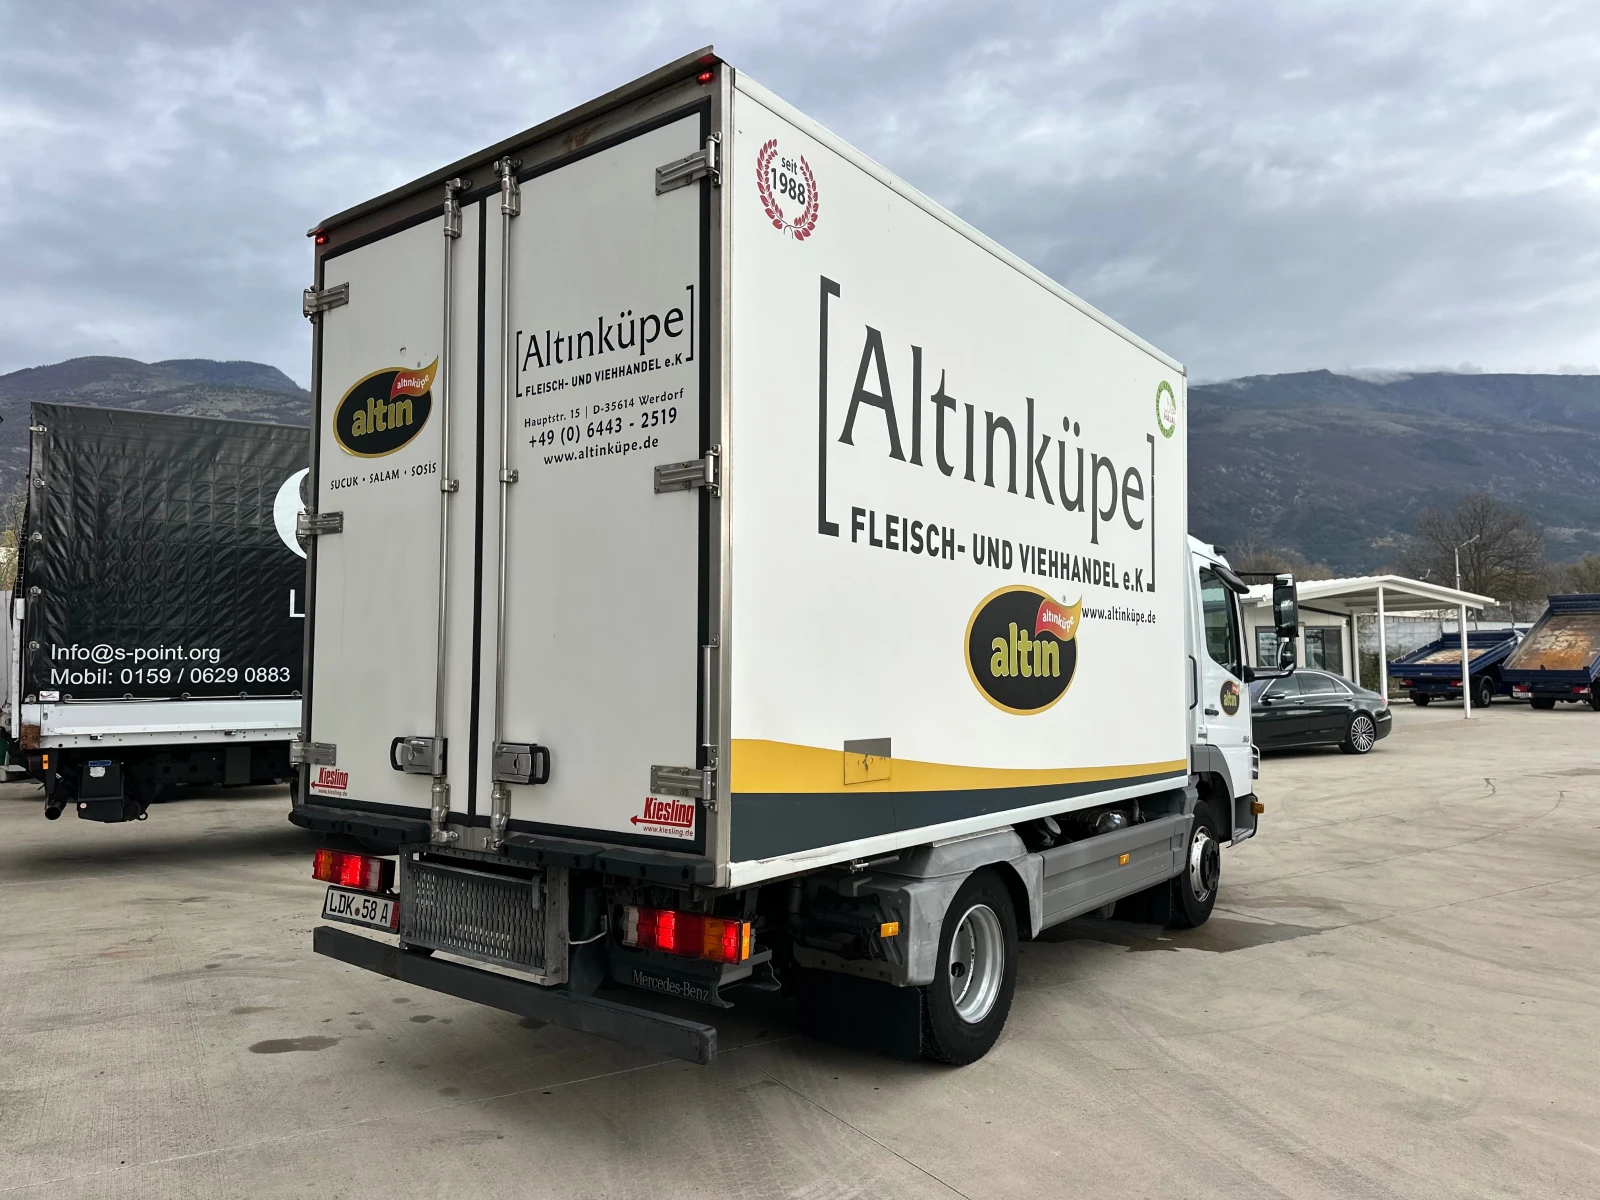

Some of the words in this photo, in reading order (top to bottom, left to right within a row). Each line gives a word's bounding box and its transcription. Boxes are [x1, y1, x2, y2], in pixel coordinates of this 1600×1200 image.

[781, 157, 797, 175] seit
[771, 167, 806, 205] 1988
[525, 379, 569, 397] FLEISCH-
[571, 373, 592, 387] UND
[595, 358, 662, 382] VIEHHANDEL
[664, 353, 683, 368] e.K
[524, 412, 567, 428] Hauptstr.
[570, 408, 581, 419] 15
[593, 398, 635, 415] D-35614
[639, 388, 684, 406] Werdorf
[529, 429, 555, 448] +49
[560, 424, 581, 445] (0)
[586, 416, 622, 439] 6443
[641, 407, 677, 429] 2519
[543, 436, 659, 465] www.altinküpe.de
[330, 475, 359, 491] SUCUK
[369, 469, 400, 484] SALAM
[851, 505, 966, 561] FLEISCH-
[972, 533, 1013, 570] UND
[1019, 543, 1119, 589] VIEHHANDEL
[1122, 567, 1144, 593] e.K
[51, 643, 220, 665] Info@s-point.org
[50, 668, 113, 686] Mobil:
[121, 668, 171, 685] 0159
[190, 667, 238, 684] 0629
[244, 666, 291, 683] 0883
[318, 767, 349, 788] Kiesling
[643, 797, 695, 826] Kiesling
[643, 826, 693, 838] www.kiesling.de
[329, 892, 355, 916] LDK
[361, 899, 378, 921] 58
[380, 903, 389, 924] A
[632, 969, 709, 1002] Mercedes-Benz
